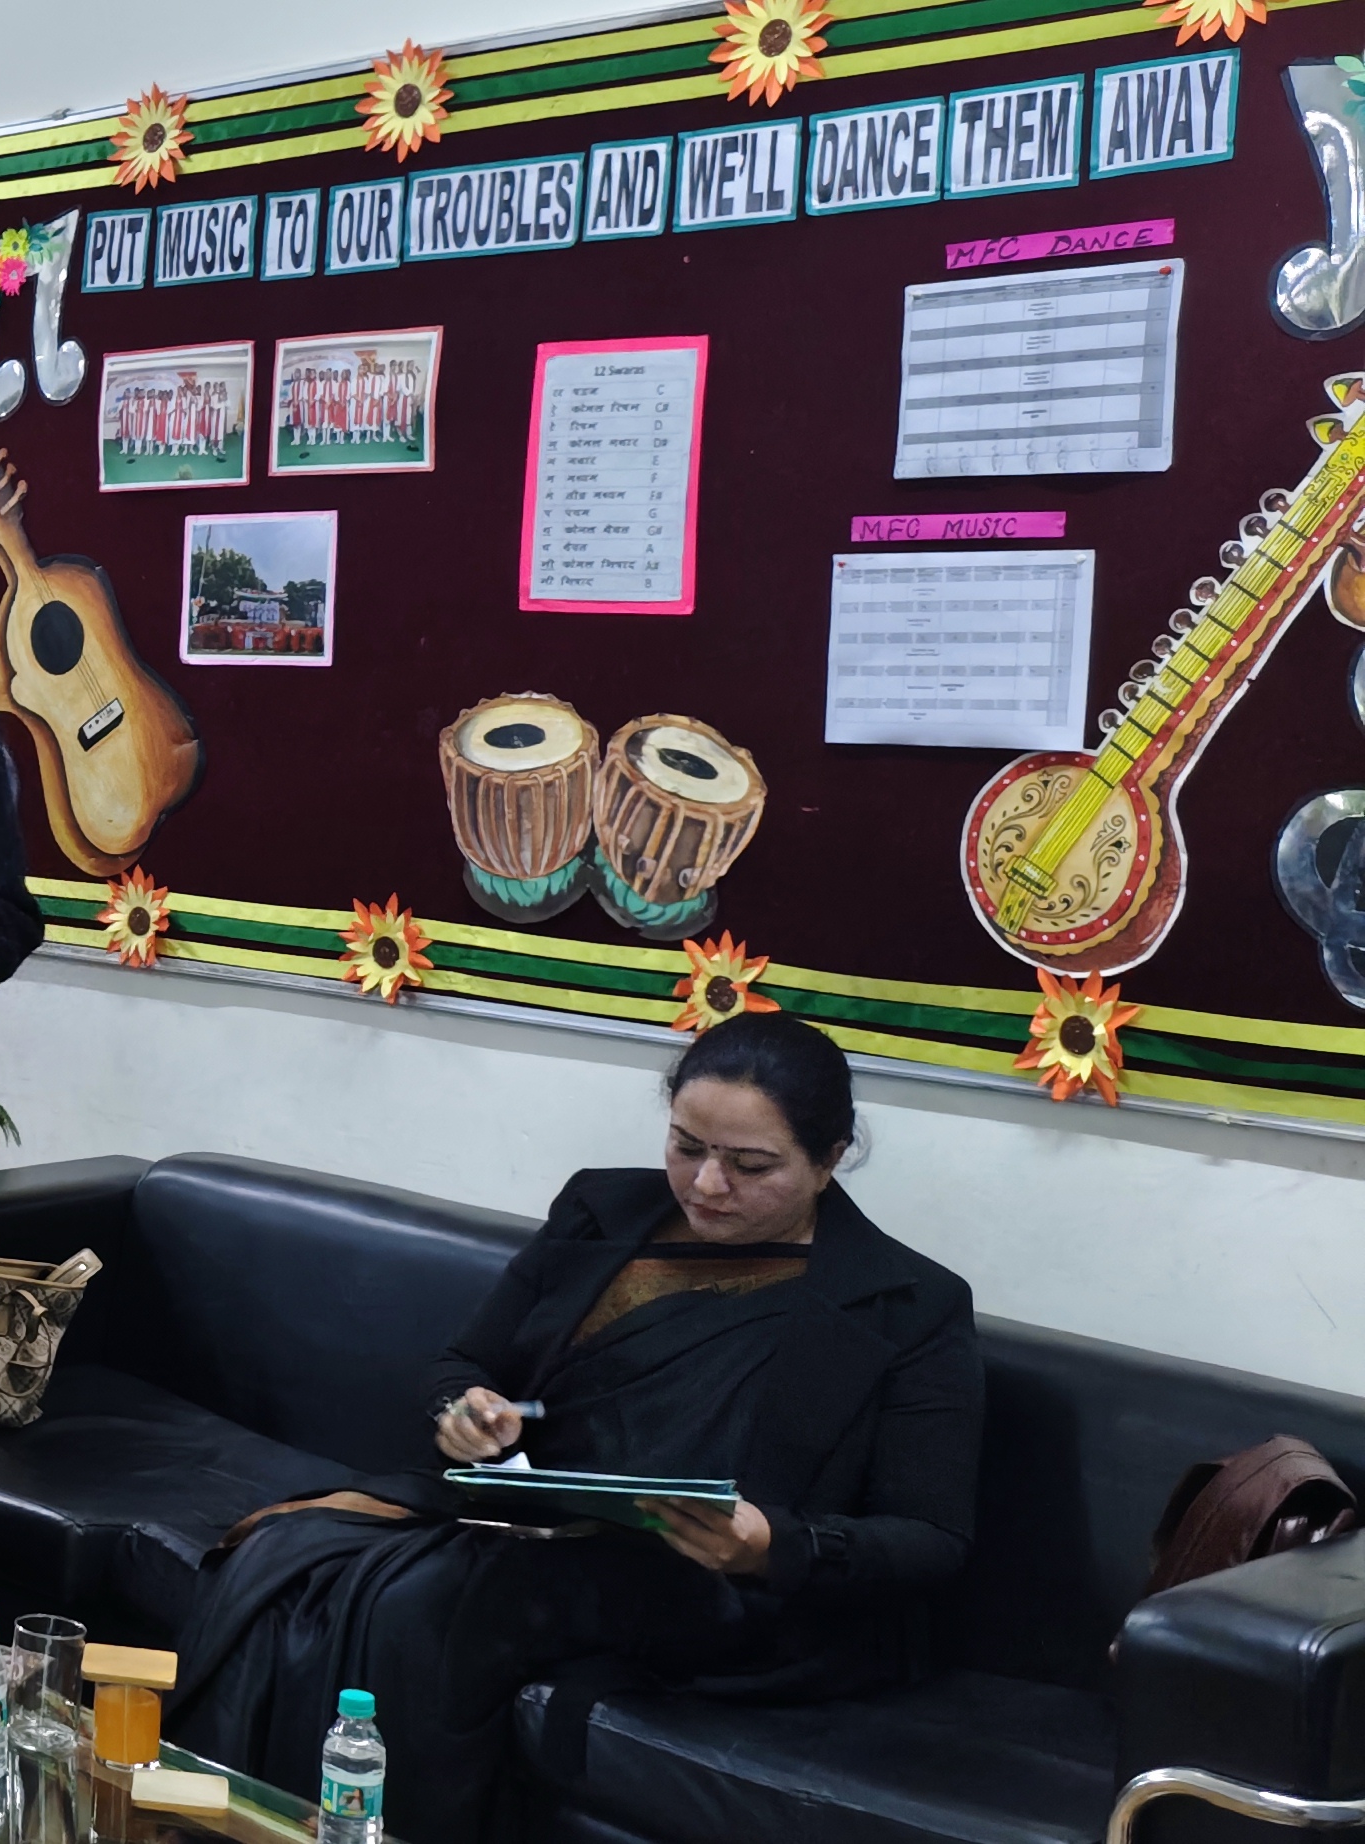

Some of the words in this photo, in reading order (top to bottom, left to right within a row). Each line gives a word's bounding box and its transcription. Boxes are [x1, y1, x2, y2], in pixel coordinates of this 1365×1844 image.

[90, 216, 144, 285] PUT
[162, 202, 249, 279] MUSIC
[275, 198, 309, 270] TO
[336, 187, 393, 264] OUR
[416, 163, 573, 252] TROUBLES
[591, 148, 661, 231] AND
[687, 128, 787, 221] WE'LL
[819, 109, 933, 204] DANCE
[959, 88, 1071, 187] THEM
[1105, 59, 1229, 166] AWAY
[950, 237, 1020, 269] MFC
[1046, 228, 1154, 256] DANCE
[656, 383, 666, 396] C
[653, 419, 664, 431] D
[651, 454, 660, 467] E
[650, 471, 659, 484] F
[648, 507, 658, 519] G
[859, 517, 920, 541] MFC
[942, 516, 1018, 539] MUSIC
